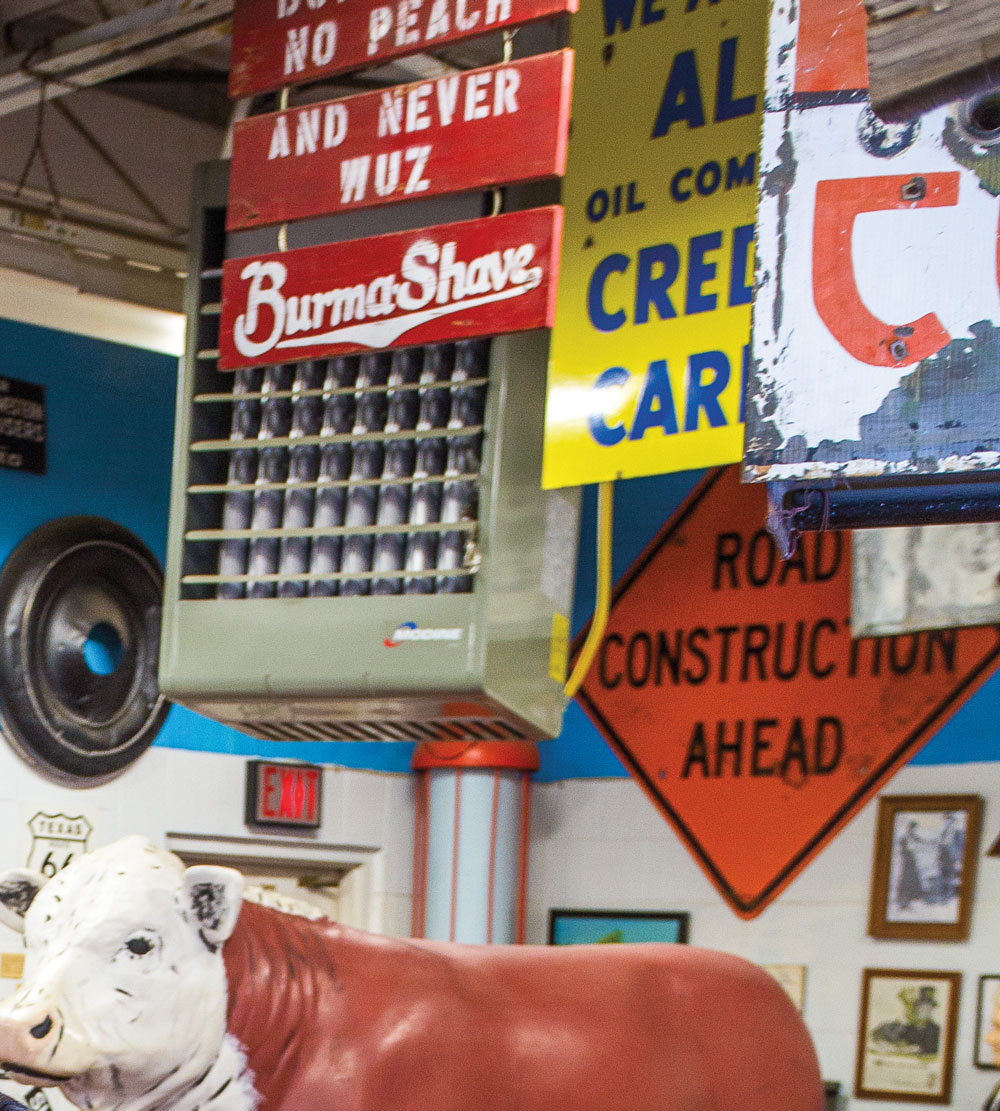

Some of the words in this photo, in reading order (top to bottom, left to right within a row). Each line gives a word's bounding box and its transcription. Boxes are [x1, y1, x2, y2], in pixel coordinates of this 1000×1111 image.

[284, 20, 338, 76] NO
[367, 0, 512, 56] PEACH
[267, 103, 349, 160] AND
[378, 68, 522, 137] NEVER
[651, 36, 757, 139] AL
[340, 145, 433, 204] WUZ
[586, 181, 645, 223] OIL
[670, 151, 757, 204] COM
[586, 345, 748, 447] CAR
[711, 531, 842, 591] ROAD
[681, 716, 845, 779] AHEAD
[262, 766, 319, 820] EXIT
